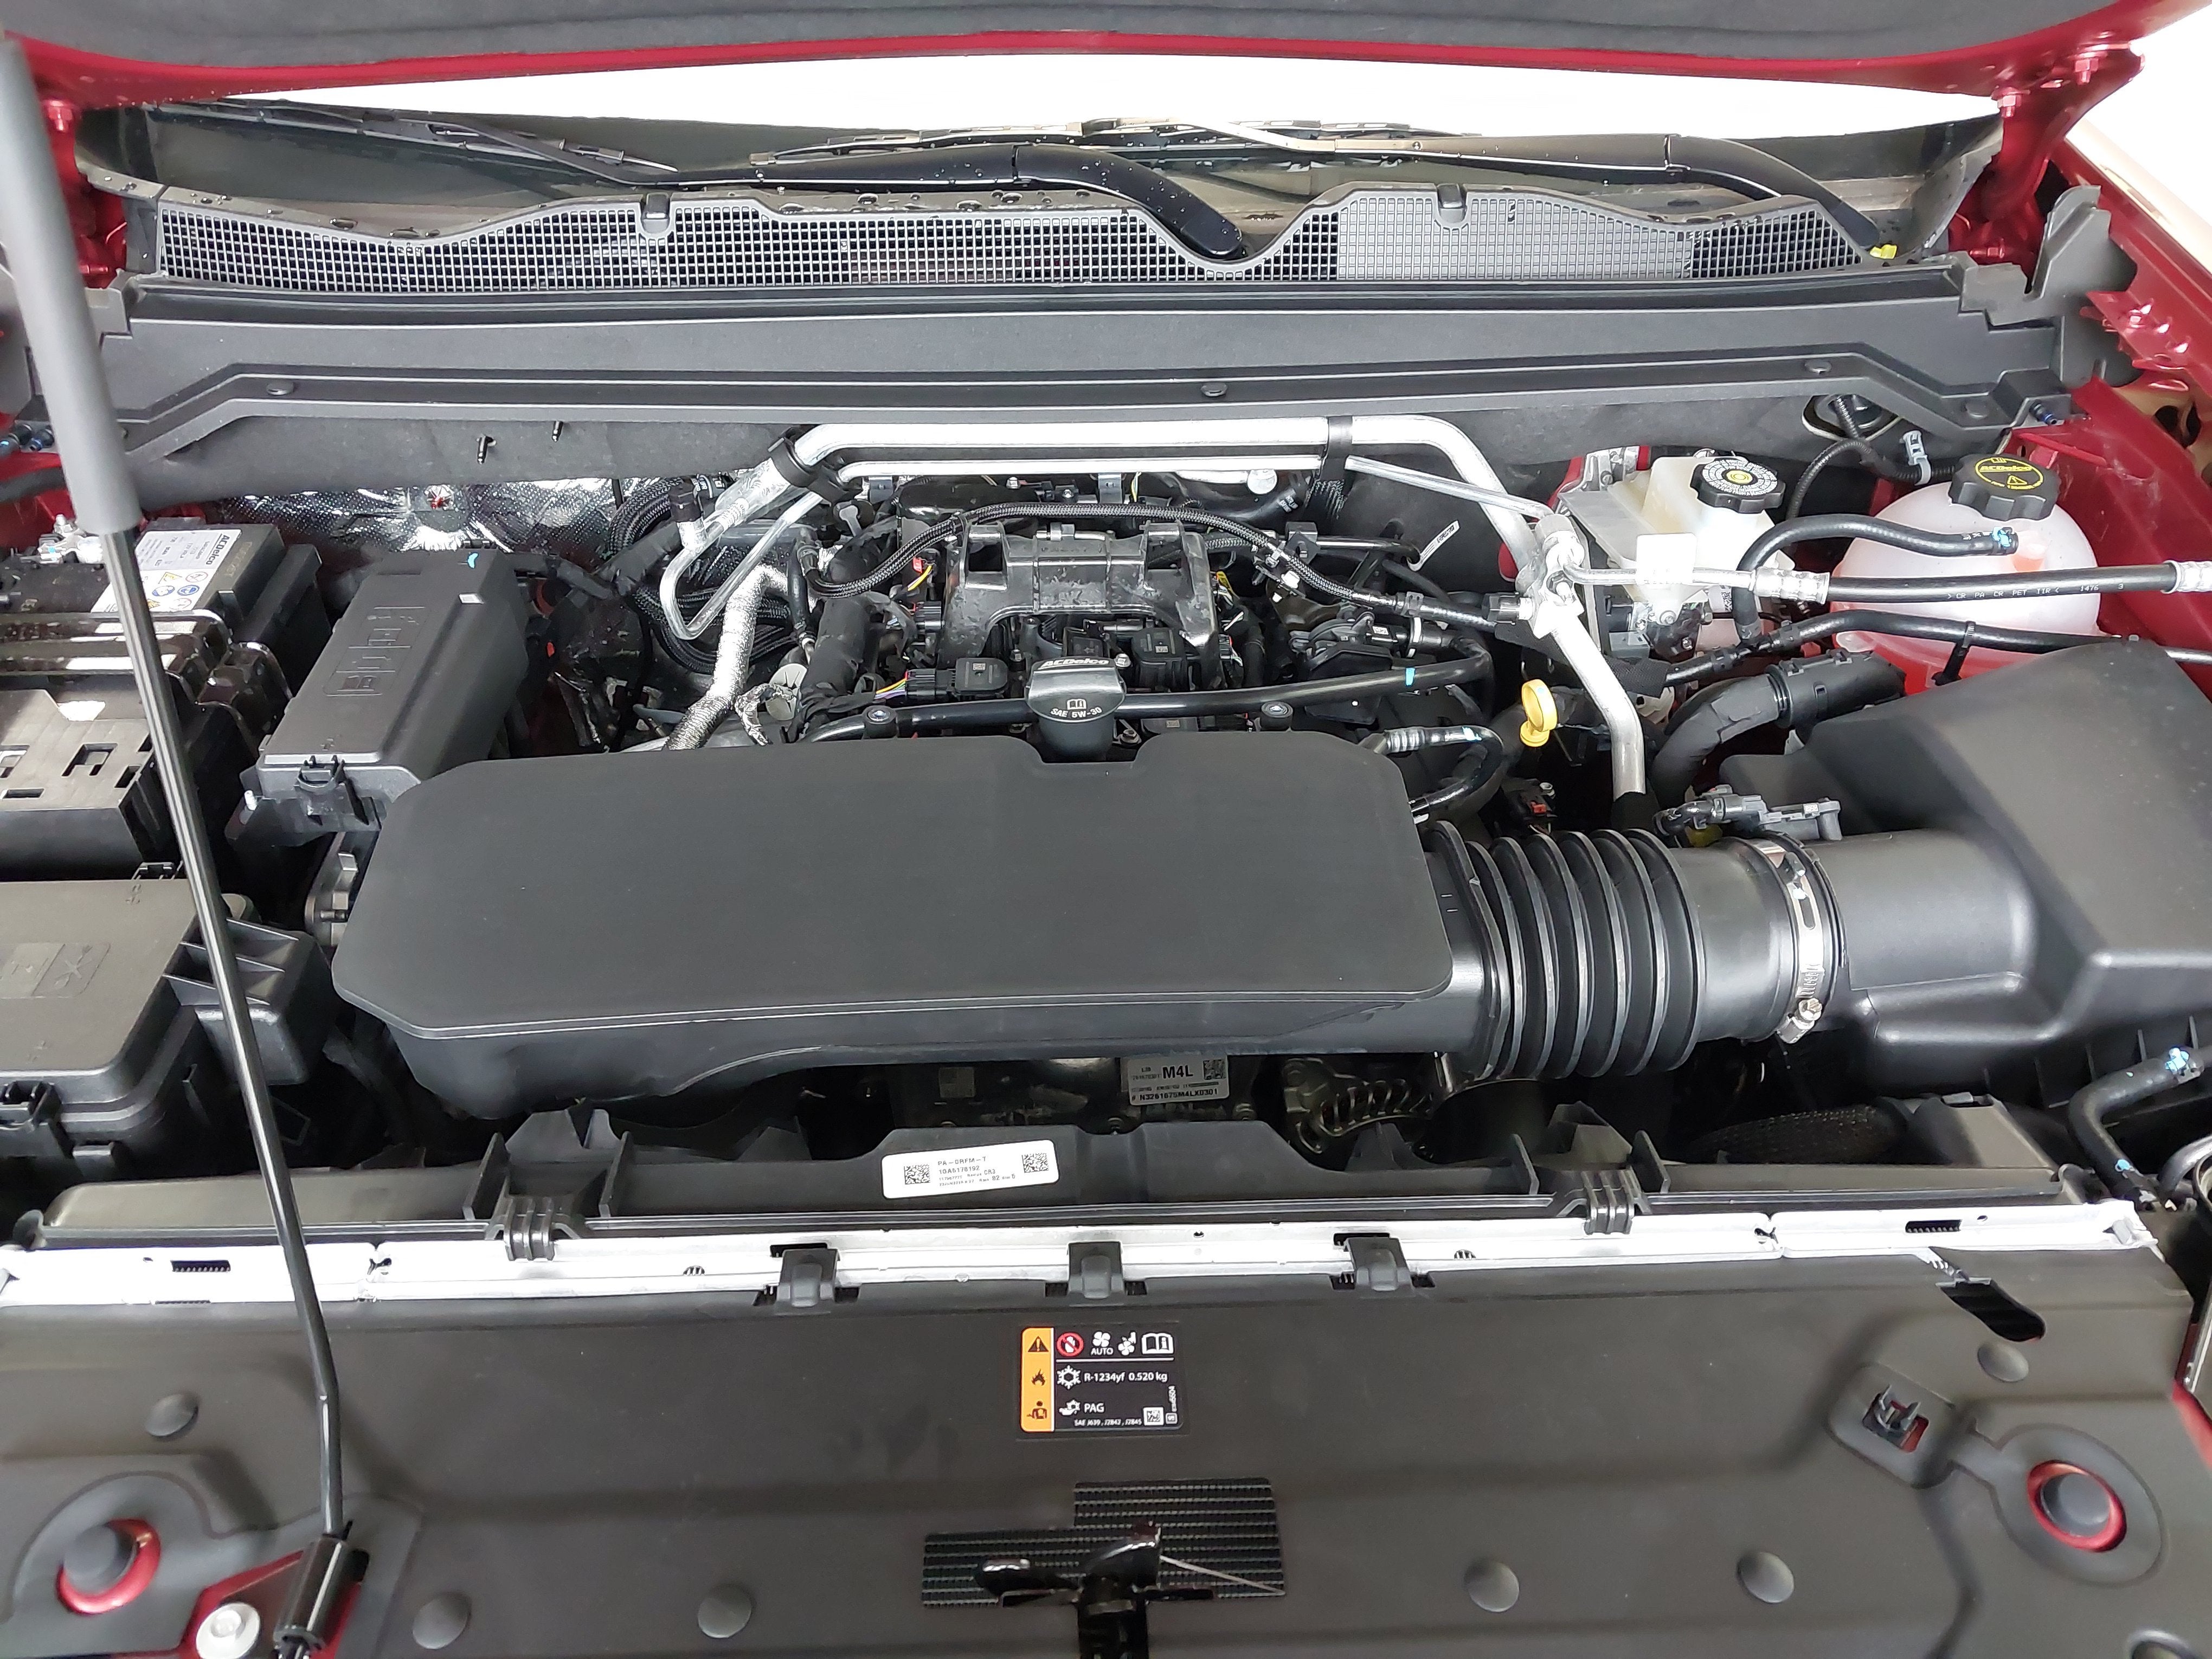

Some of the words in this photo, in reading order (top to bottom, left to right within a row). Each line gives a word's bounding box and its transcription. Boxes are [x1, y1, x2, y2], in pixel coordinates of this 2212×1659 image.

[206, 535, 230, 565] ACDelco
[1039, 658, 1109, 668] ACDelco
[1050, 708, 1069, 718] SAE
[1071, 706, 1103, 718] 5W-30
[1162, 1065, 1193, 1079] M4L
[1091, 1347, 1114, 1356] AUTO
[1084, 1372, 1125, 1383] R-1234yf
[1128, 1372, 1154, 1382] 0.520
[1156, 1372, 1168, 1383] kg
[1084, 1403, 1105, 1413] PAG
